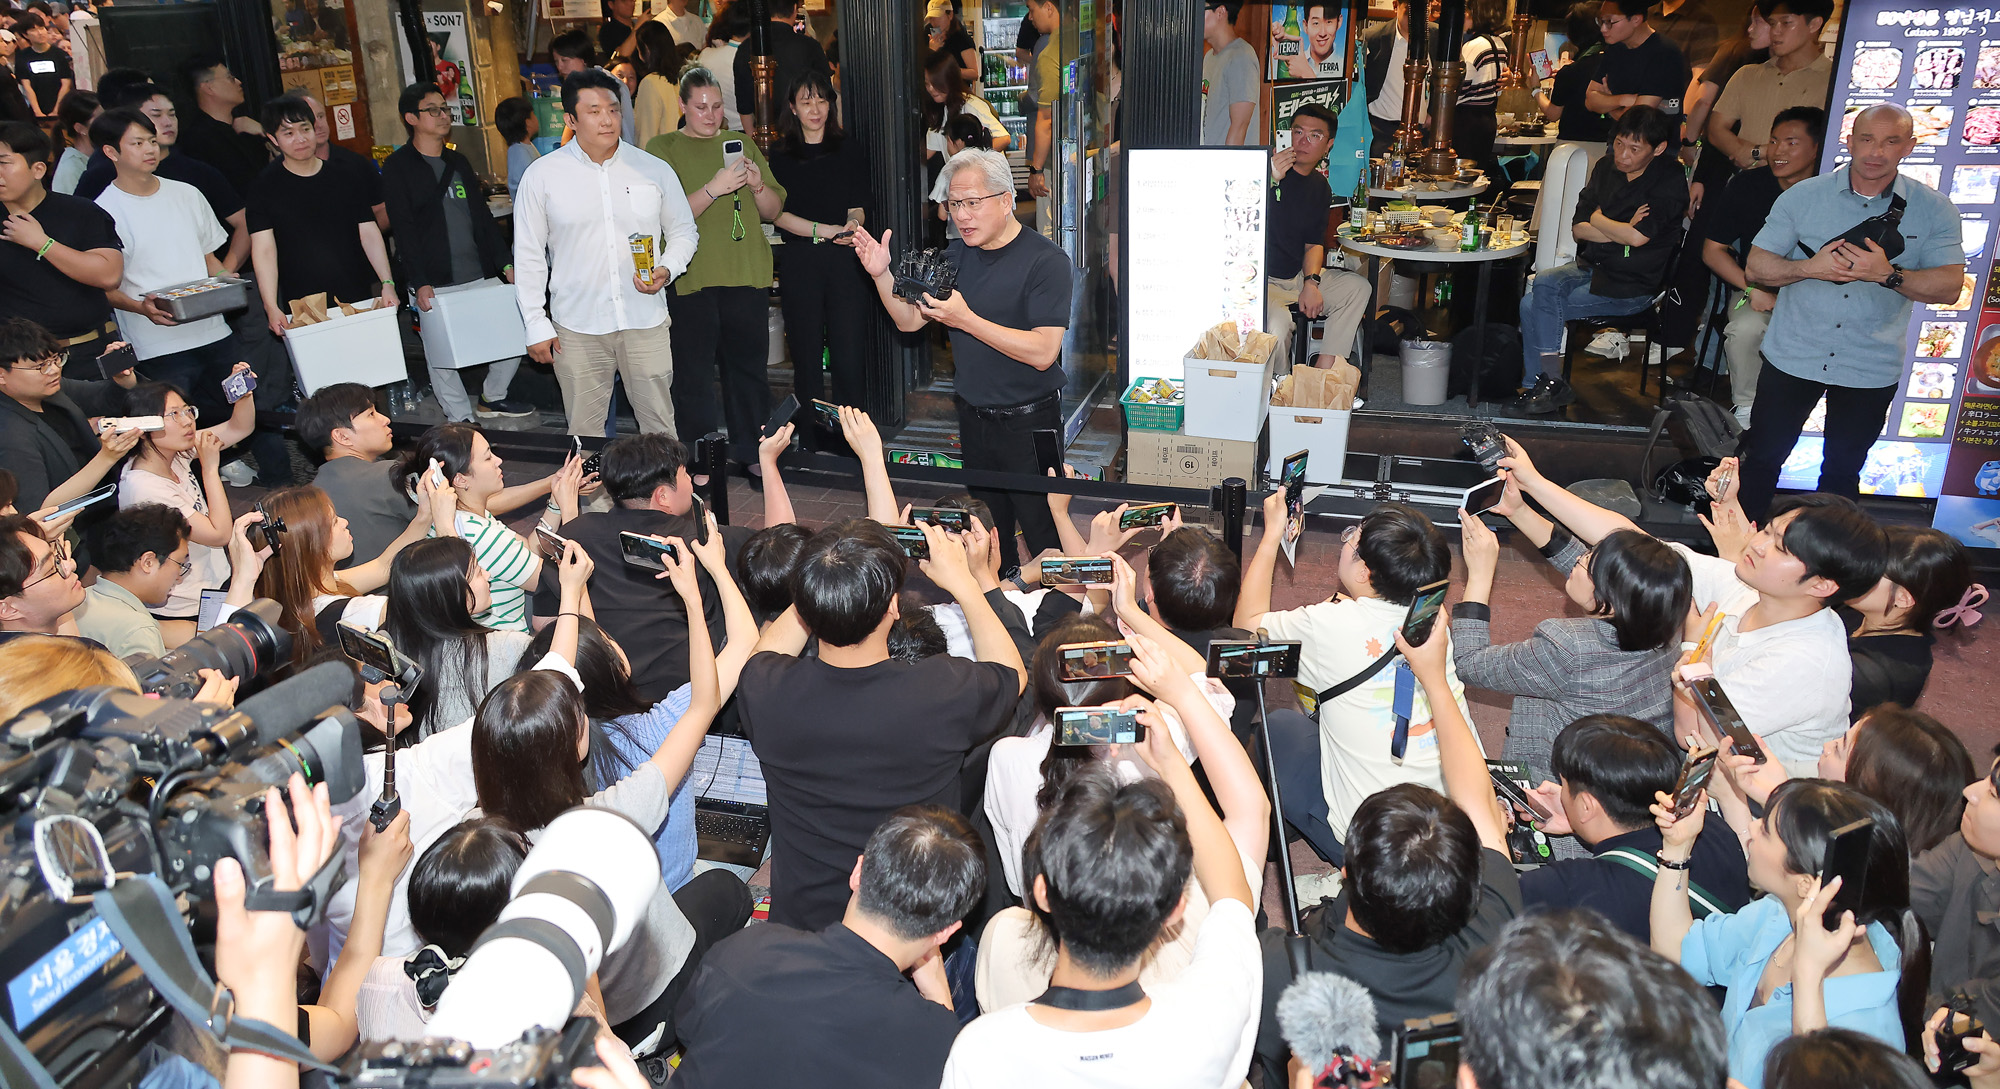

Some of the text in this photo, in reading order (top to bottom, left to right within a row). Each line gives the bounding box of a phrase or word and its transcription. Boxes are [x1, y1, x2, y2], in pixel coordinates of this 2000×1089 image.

[1319, 62, 1339, 72] TERRA
[1968, 410, 2000, 419] 辛口ラー
